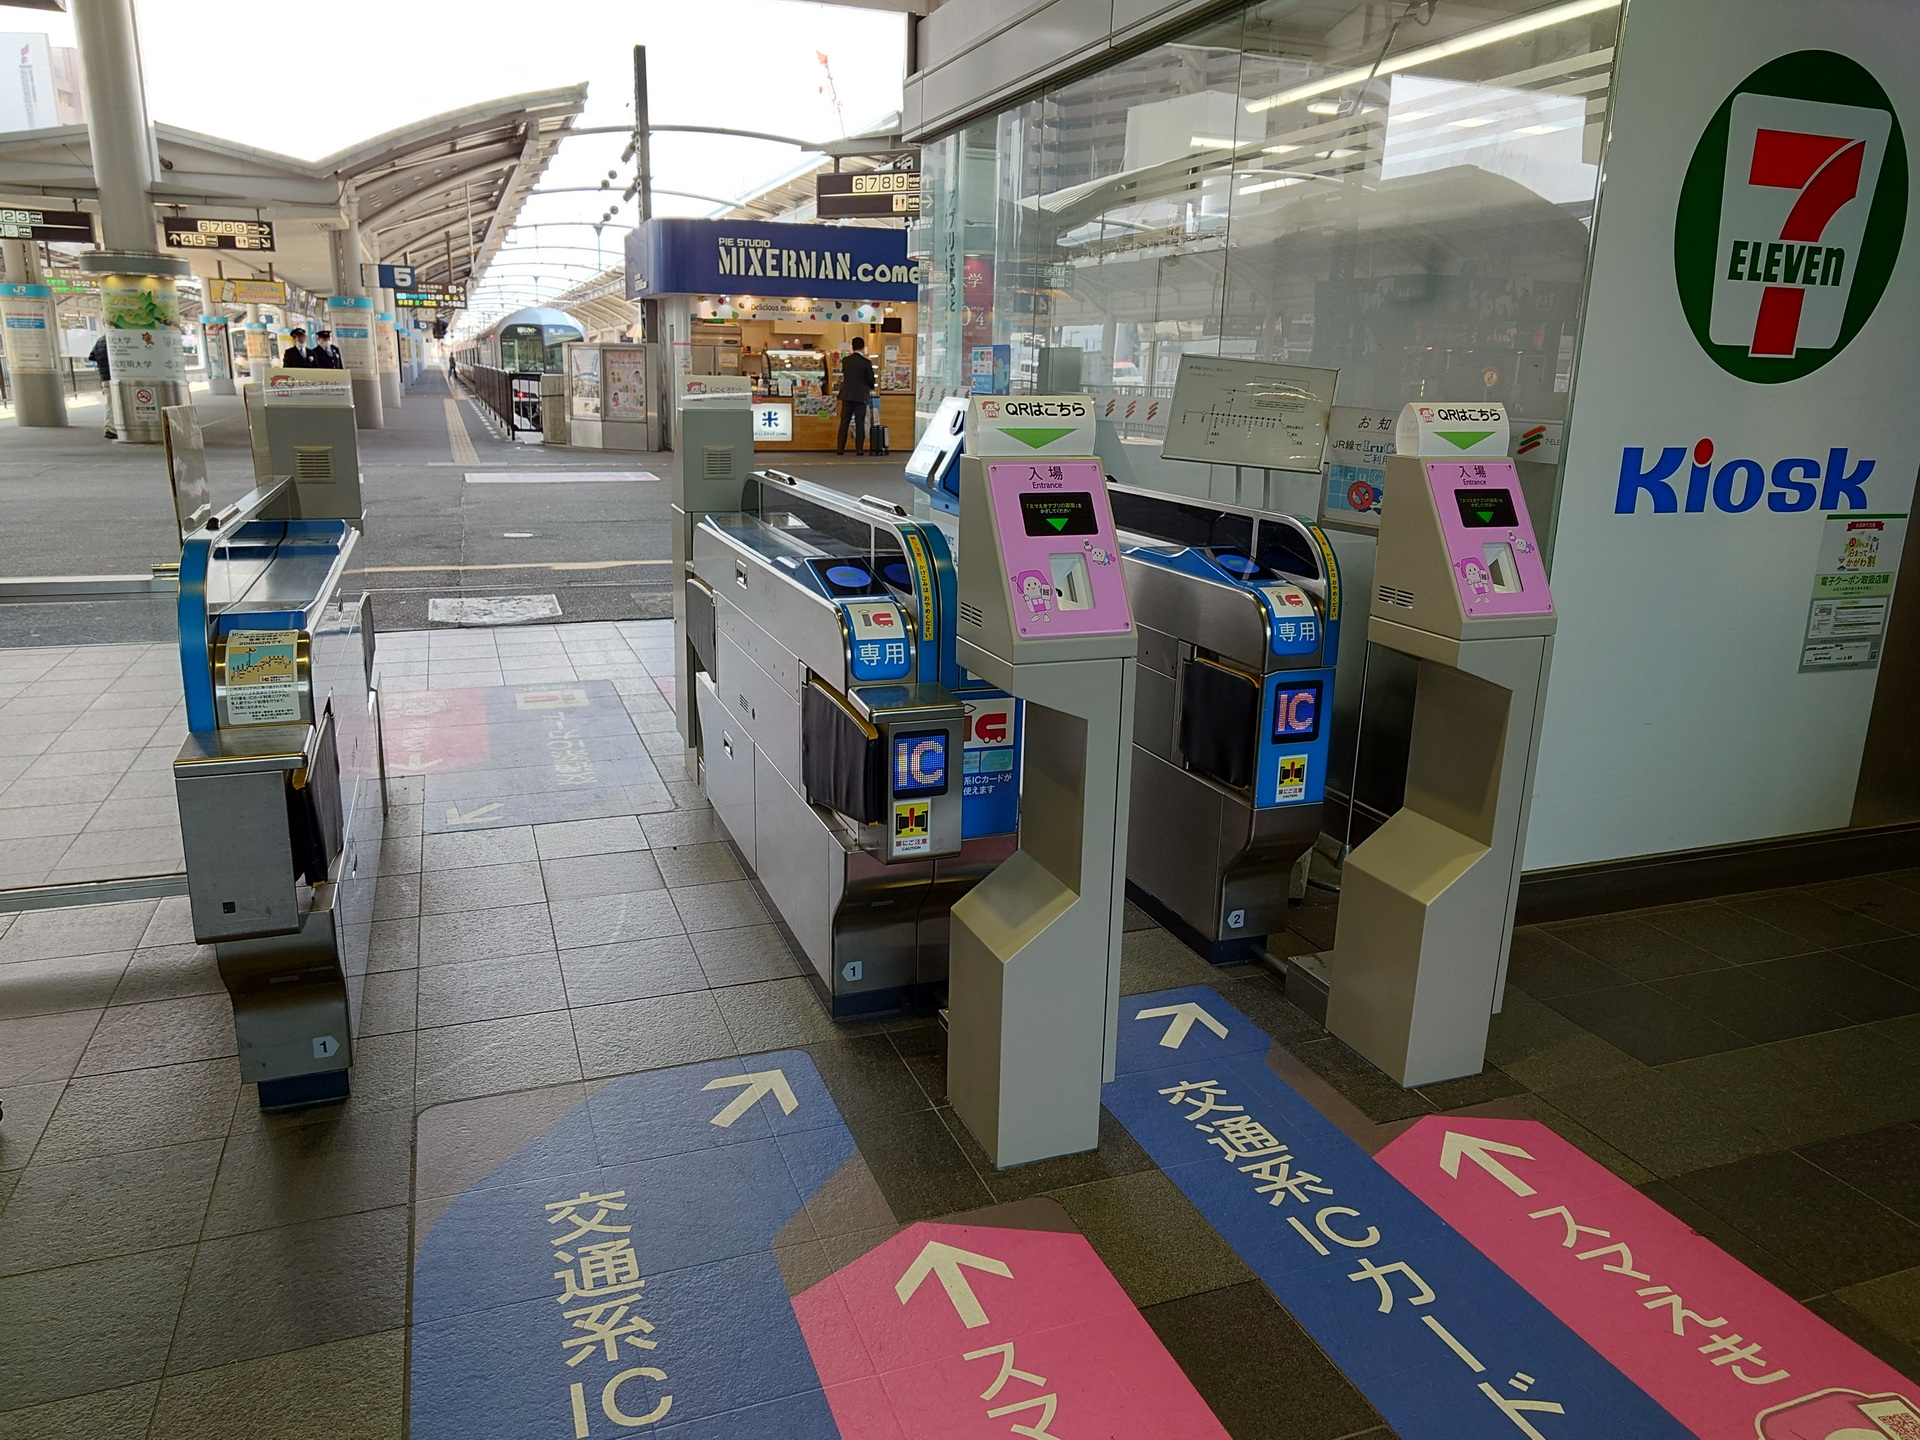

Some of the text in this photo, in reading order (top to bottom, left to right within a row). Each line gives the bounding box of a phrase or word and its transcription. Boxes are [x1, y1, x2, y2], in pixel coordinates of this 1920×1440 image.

[718, 237, 771, 248] PIE STUDIO
[393, 267, 412, 287] 5
[751, 303, 778, 312] Delicious
[808, 305, 824, 313] smile
[1005, 402, 1086, 418] QRはこちら
[1437, 408, 1501, 423] QRはこちら
[1332, 440, 1362, 451] JR線で
[1028, 465, 1064, 481] 入場
[1458, 464, 1487, 479] 入場
[1613, 437, 1877, 515] Kiosk
[1032, 481, 1063, 489] Entrance
[1820, 574, 1890, 587] 電子クーポン取扱店舗
[923, 595, 932, 639] おやめください
[1278, 621, 1316, 643] 専用
[858, 642, 905, 667] 専用
[1277, 692, 1315, 732] IC
[898, 740, 944, 787] IC
[963, 772, 1013, 786] 系ICカードが
[963, 785, 995, 796] 使えます
[1233, 913, 1241, 925] 2
[319, 1041, 328, 1054] 1
[1157, 1079, 1566, 1440] 交通系ICカード
[1527, 1204, 1791, 1385] スマえき
[544, 1189, 673, 1440] 交通系IC
[962, 1341, 1063, 1440] スマ
